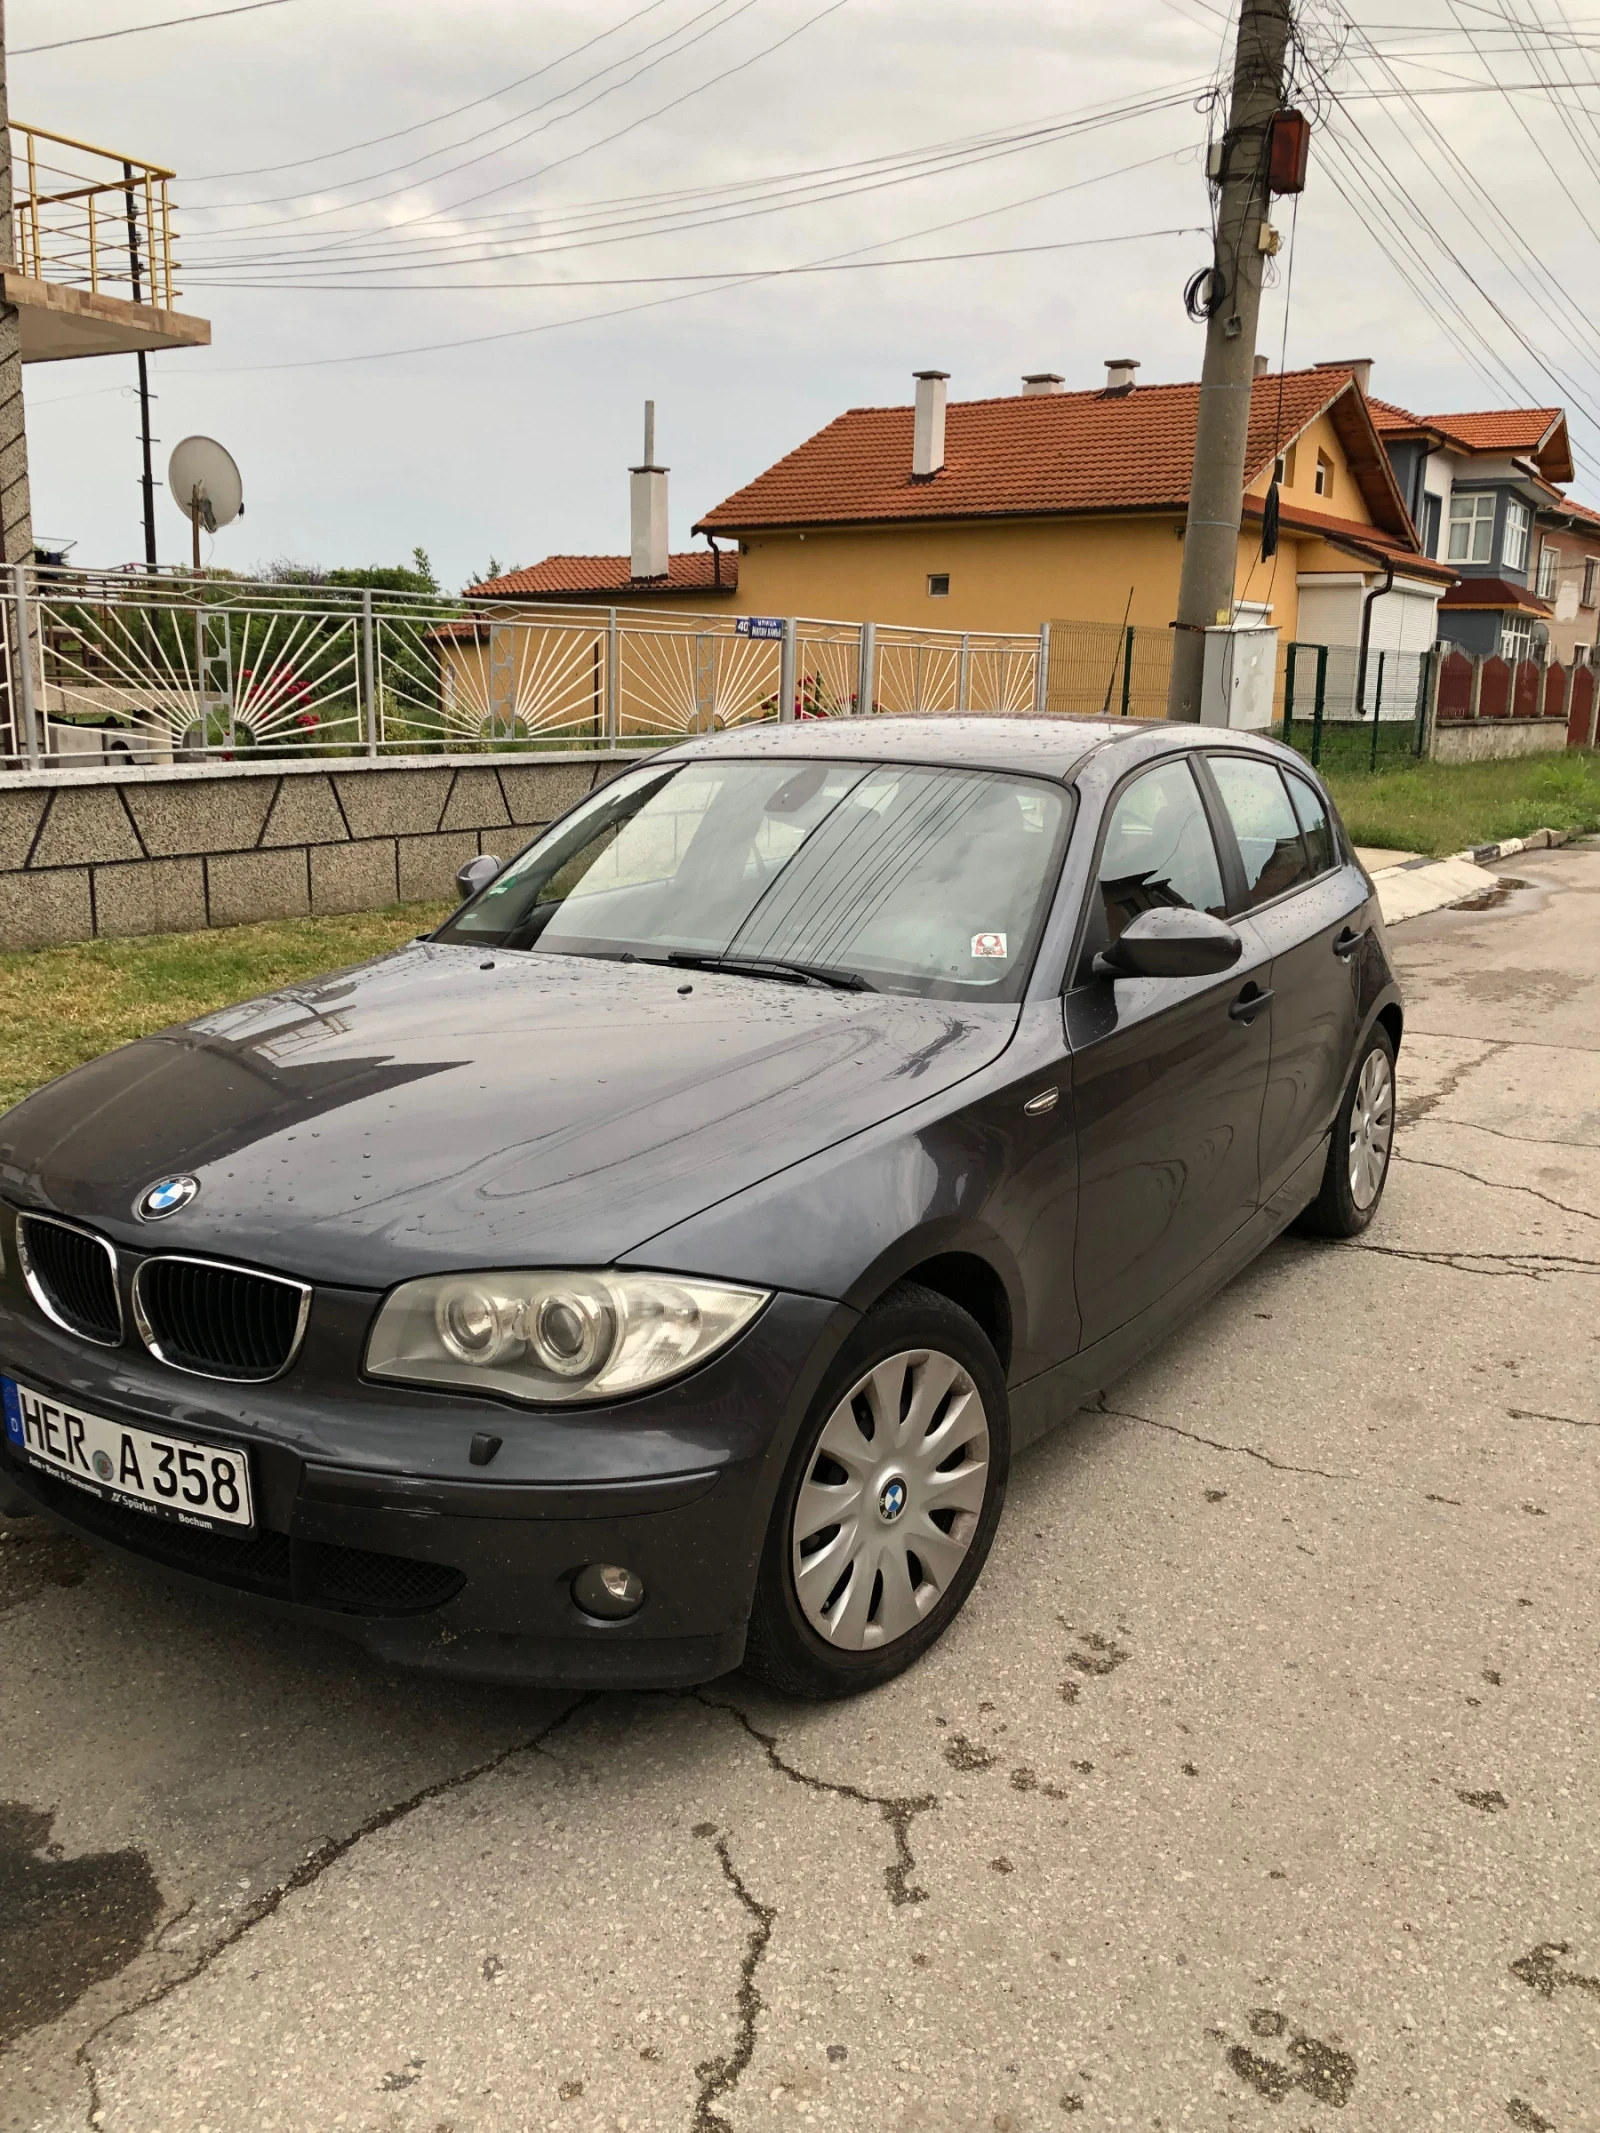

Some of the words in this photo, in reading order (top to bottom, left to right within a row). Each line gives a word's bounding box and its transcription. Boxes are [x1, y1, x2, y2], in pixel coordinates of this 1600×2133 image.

[738, 621, 749, 632] 40
[11, 1418, 19, 1432] D
[20, 1393, 90, 1471] HER
[151, 1441, 240, 1514] 358
[178, 1513, 213, 1530] Bochum
